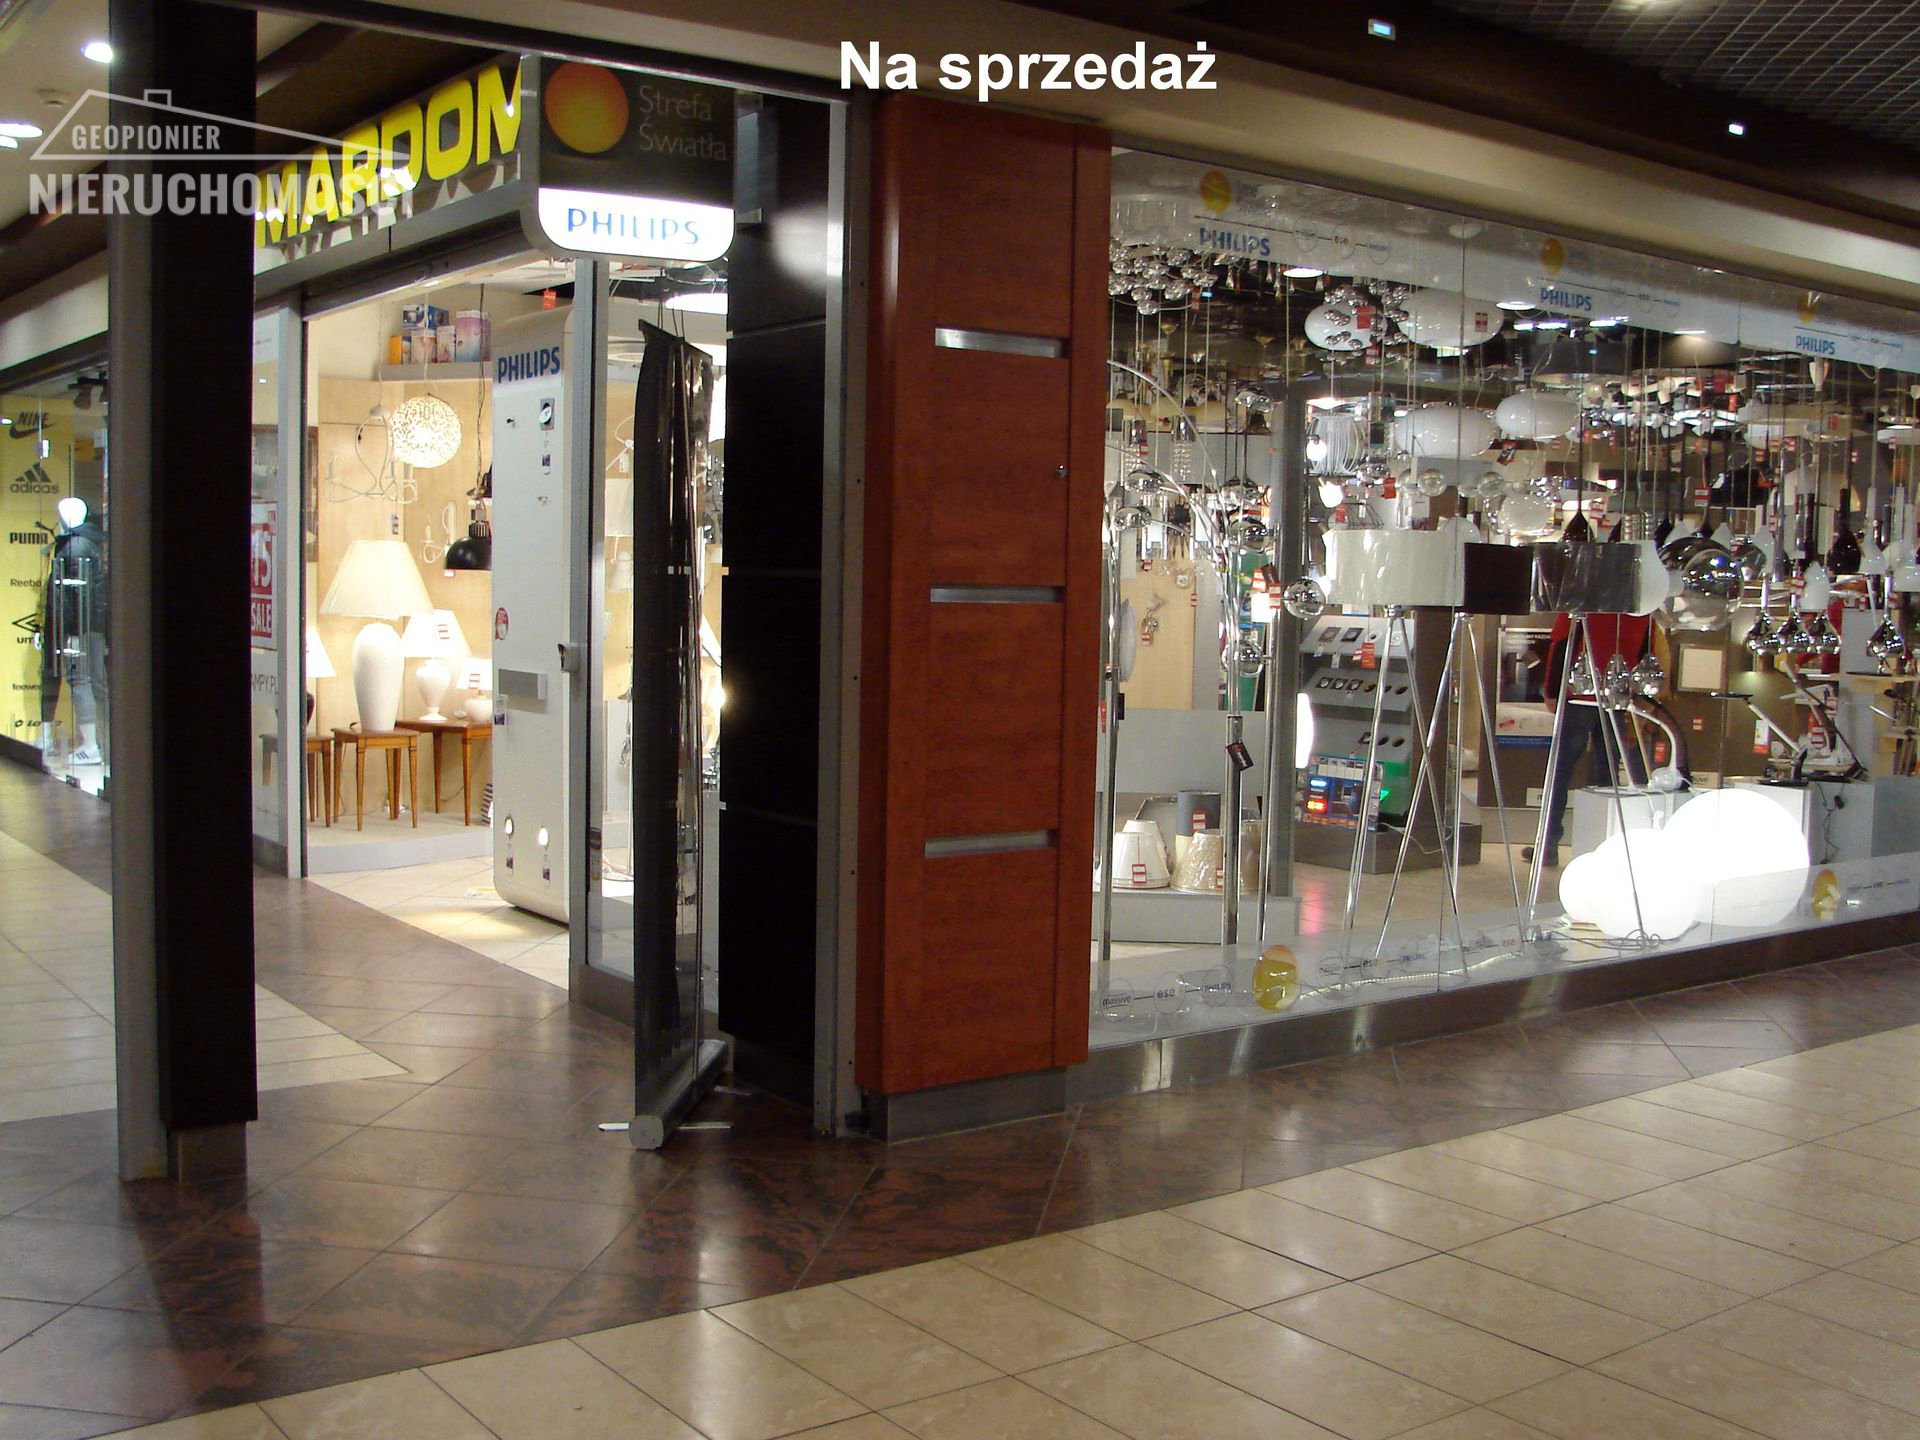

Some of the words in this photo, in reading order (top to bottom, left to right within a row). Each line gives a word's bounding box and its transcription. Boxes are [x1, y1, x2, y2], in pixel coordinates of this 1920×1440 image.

[639, 84, 713, 122] Strefa
[639, 115, 728, 162] Światła
[567, 207, 700, 245] PHILIPS
[1199, 226, 1271, 257] PHILIPS
[1540, 286, 1593, 312] PHILIPS
[1795, 335, 1836, 355] PHILIPS
[497, 346, 561, 384] PHILIPS
[17, 410, 49, 427] NIKE
[9, 480, 60, 495] adidas
[10, 578, 42, 589] Reebo
[251, 602, 272, 634] SALE
